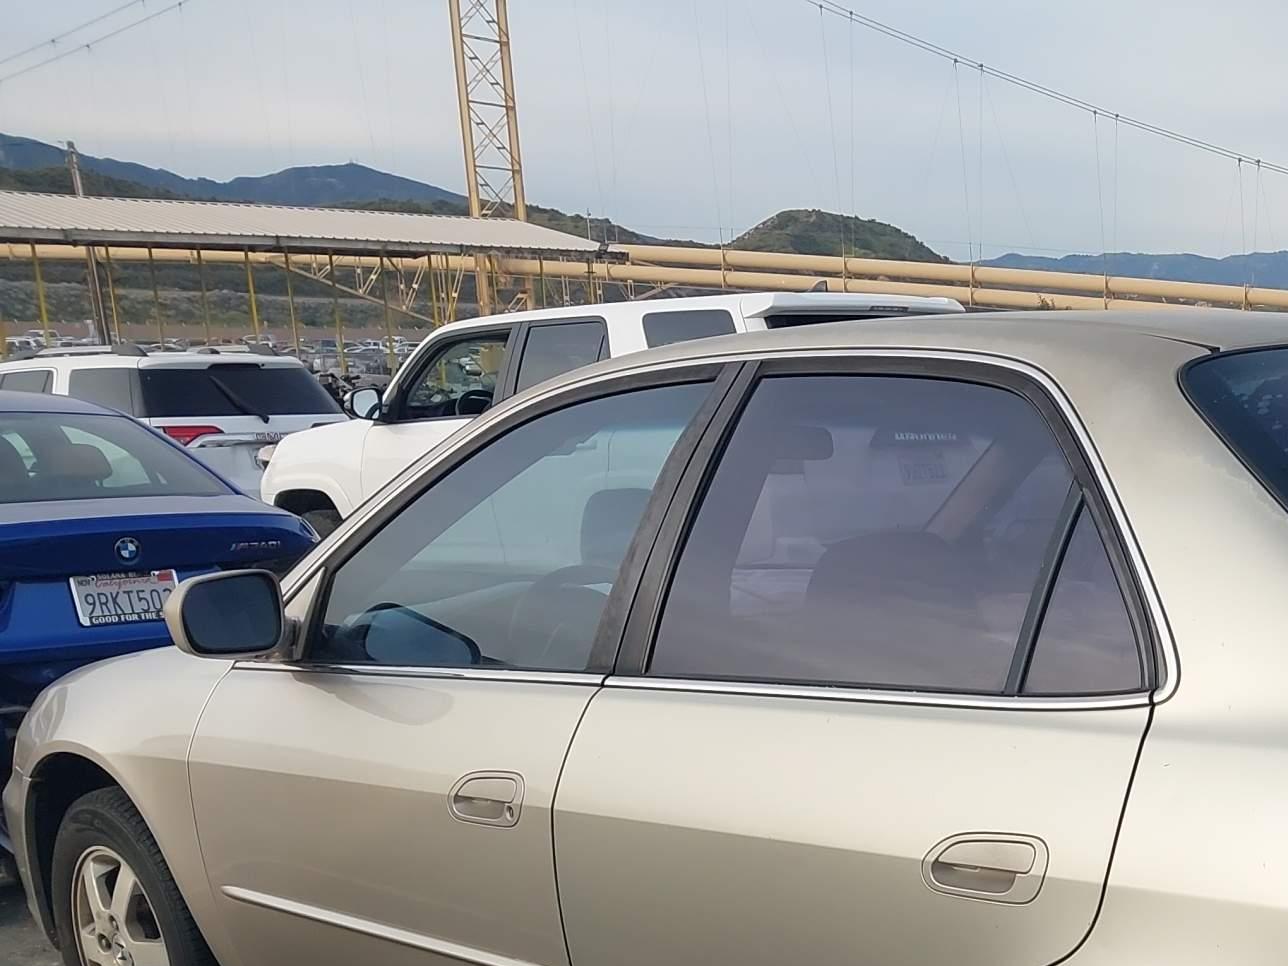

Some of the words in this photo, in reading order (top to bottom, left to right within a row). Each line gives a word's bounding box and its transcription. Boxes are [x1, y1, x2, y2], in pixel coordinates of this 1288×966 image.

[92, 615, 118, 624] GOOD
[120, 614, 139, 622] FOR
[141, 611, 158, 620] THE
